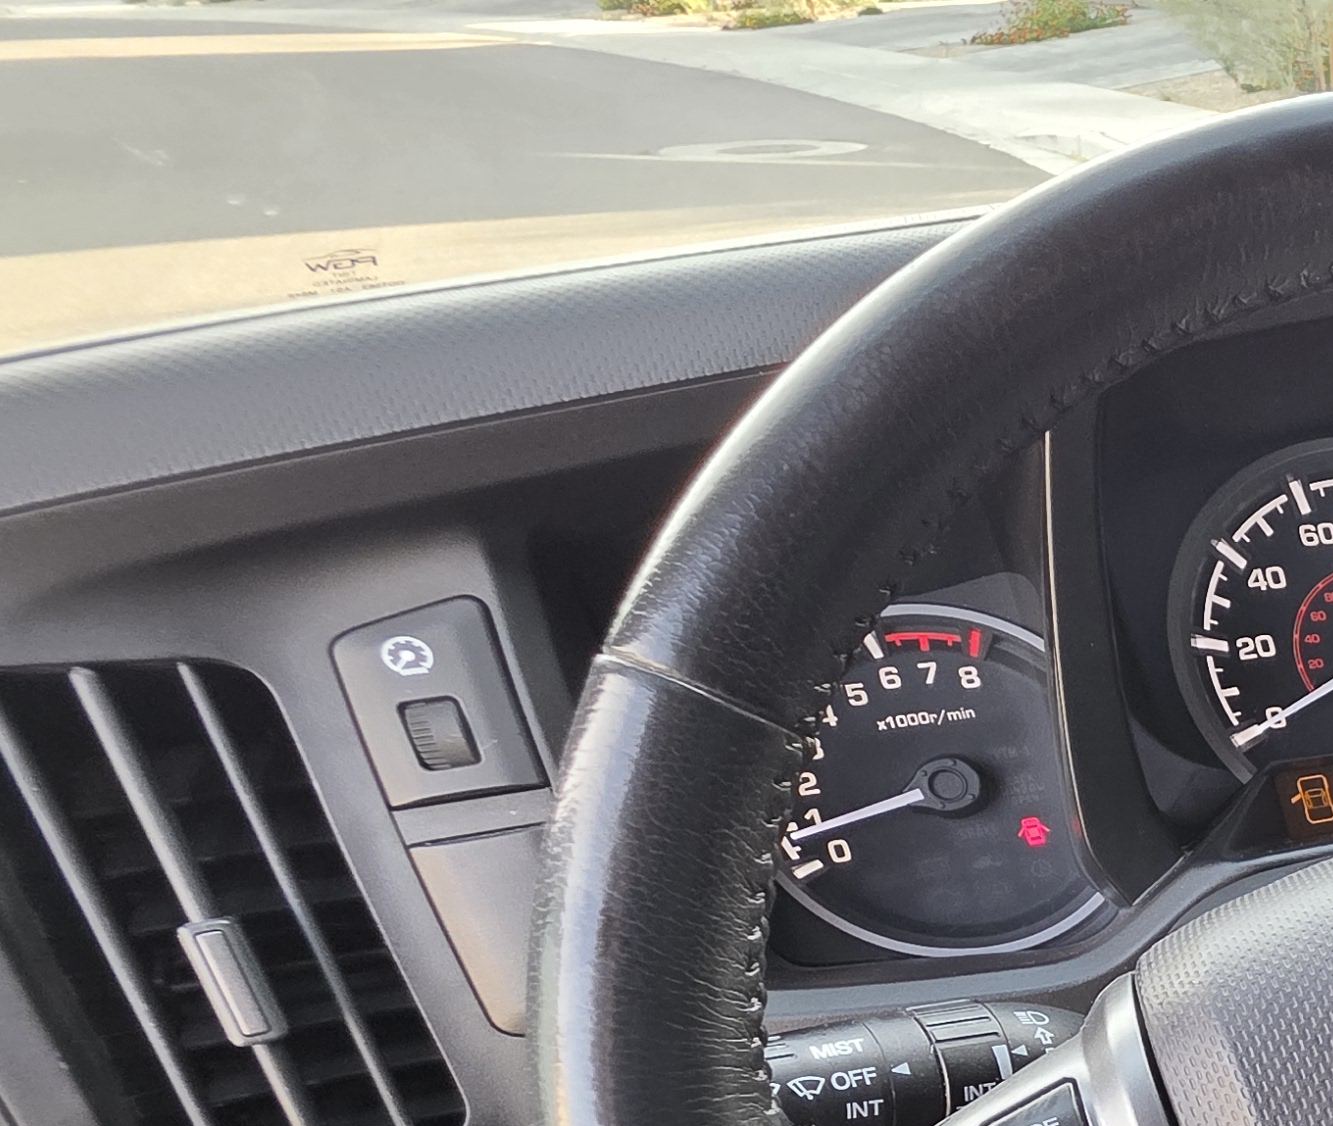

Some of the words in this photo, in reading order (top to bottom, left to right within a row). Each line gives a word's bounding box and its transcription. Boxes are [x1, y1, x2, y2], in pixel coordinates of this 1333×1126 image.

[1247, 565, 1287, 591] 40
[1309, 610, 1327, 622] 60
[1235, 634, 1277, 660] 20
[1304, 633, 1321, 644] 40
[917, 662, 937, 684] 7
[1307, 658, 1324, 669] 20
[878, 666, 901, 690] 6
[959, 666, 982, 689] 8
[845, 682, 868, 707] 5
[877, 706, 977, 732] x1000r/min
[798, 771, 821, 797] 2
[827, 838, 852, 864] 0
[808, 1037, 864, 1060] MIST
[830, 1066, 878, 1091] OFF
[846, 1098, 884, 1120] INT
